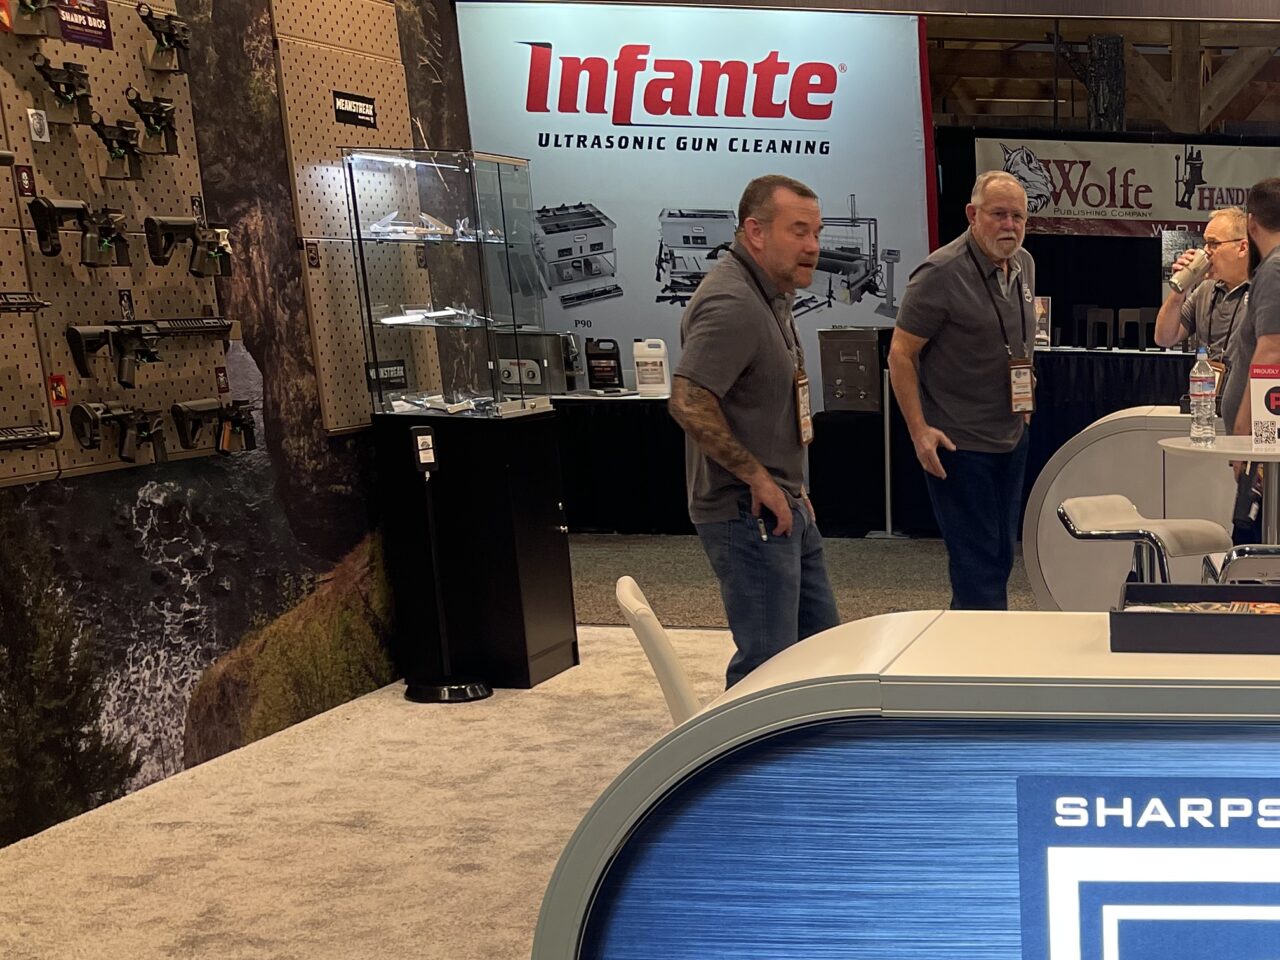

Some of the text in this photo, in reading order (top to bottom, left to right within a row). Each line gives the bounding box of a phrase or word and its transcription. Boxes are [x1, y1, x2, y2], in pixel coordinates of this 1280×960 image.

[60, 10, 86, 25] SHARPS
[87, 15, 107, 30] BROS
[335, 97, 374, 116] MEANSTREAK
[538, 132, 831, 155] ULTRASONIC GUN CLEANING
[1037, 159, 1153, 210] Wolfe
[1053, 207, 1153, 218] PUBLISHING COMPANY
[574, 319, 592, 329] P90
